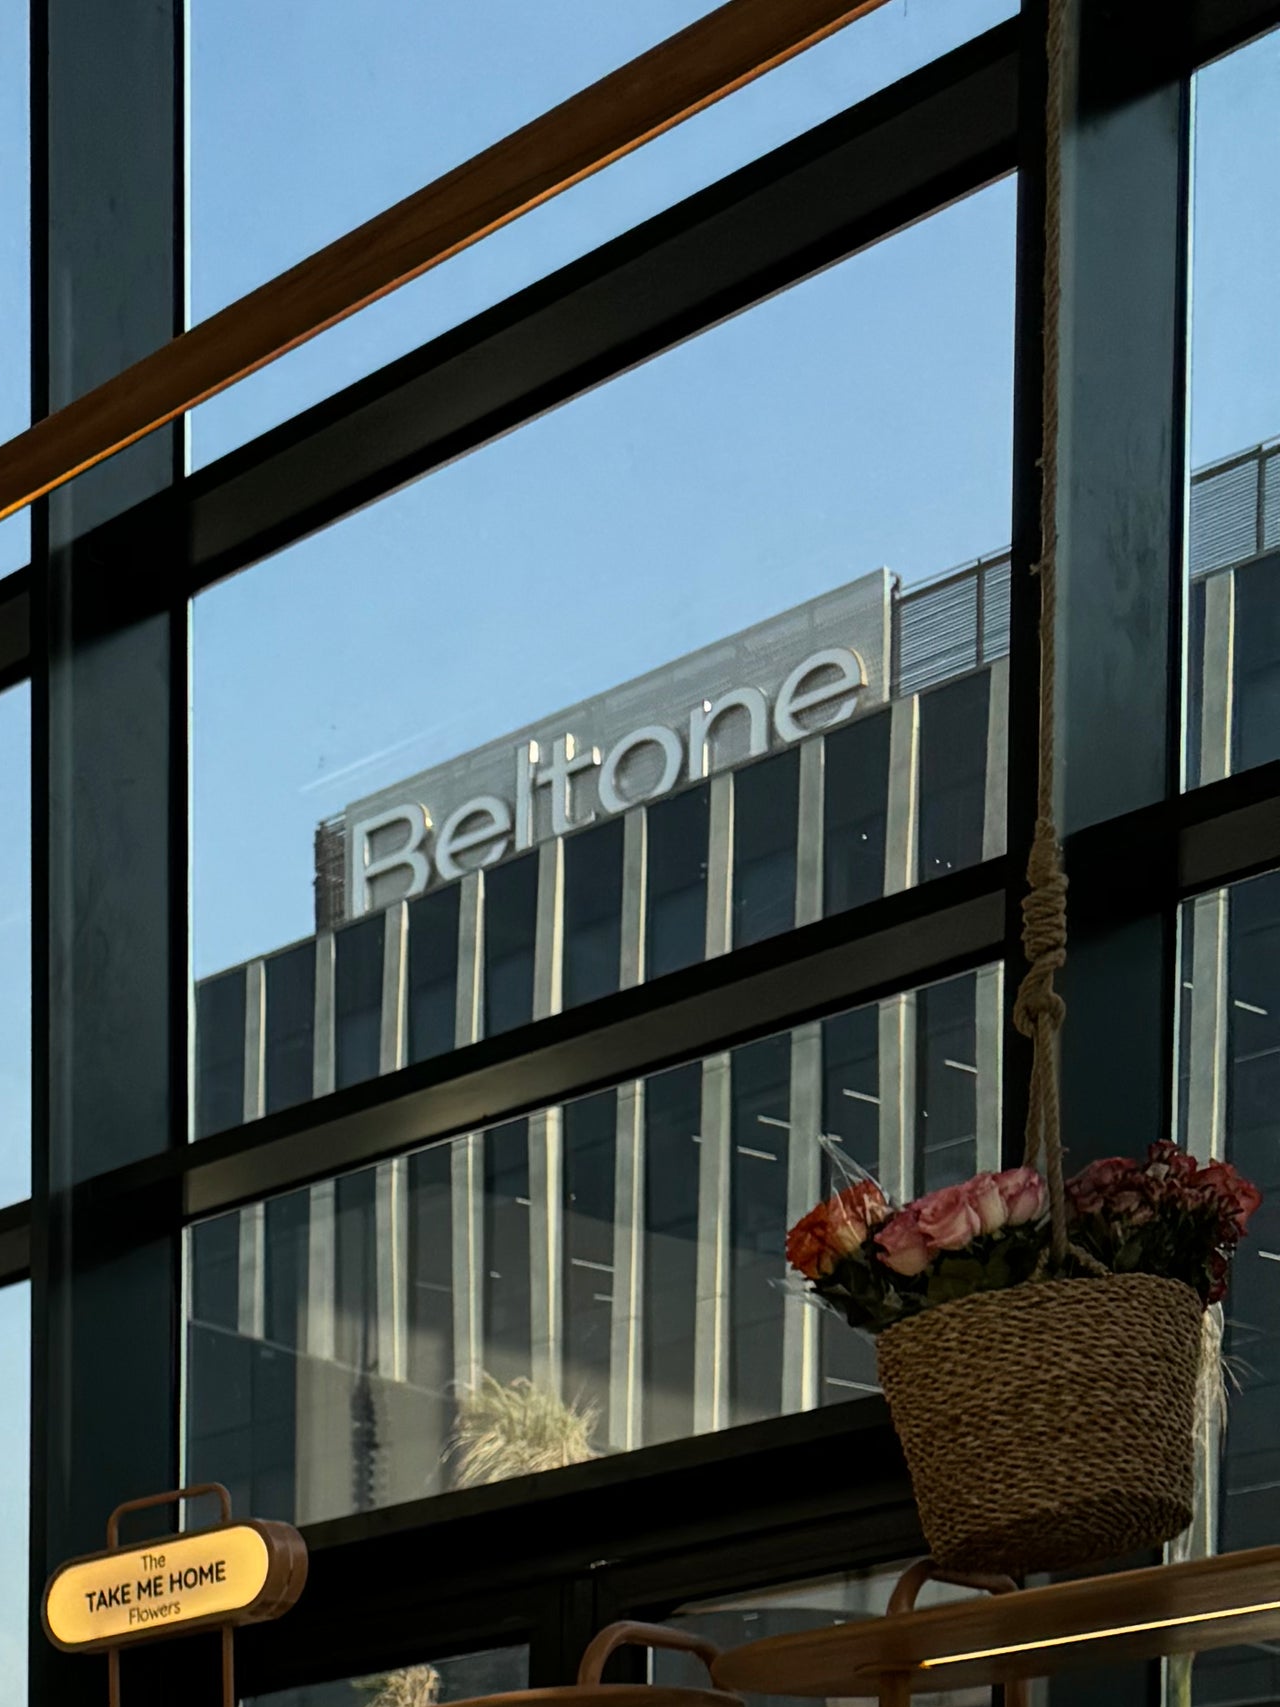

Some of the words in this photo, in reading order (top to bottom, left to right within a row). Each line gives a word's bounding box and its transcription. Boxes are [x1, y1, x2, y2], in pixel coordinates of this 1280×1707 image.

[352, 647, 868, 918] Beltone
[141, 1554, 166, 1571] The
[85, 1583, 131, 1613] TAKE
[137, 1576, 163, 1600] ME
[169, 1560, 226, 1592] HOME
[129, 1601, 181, 1625] Flowers
